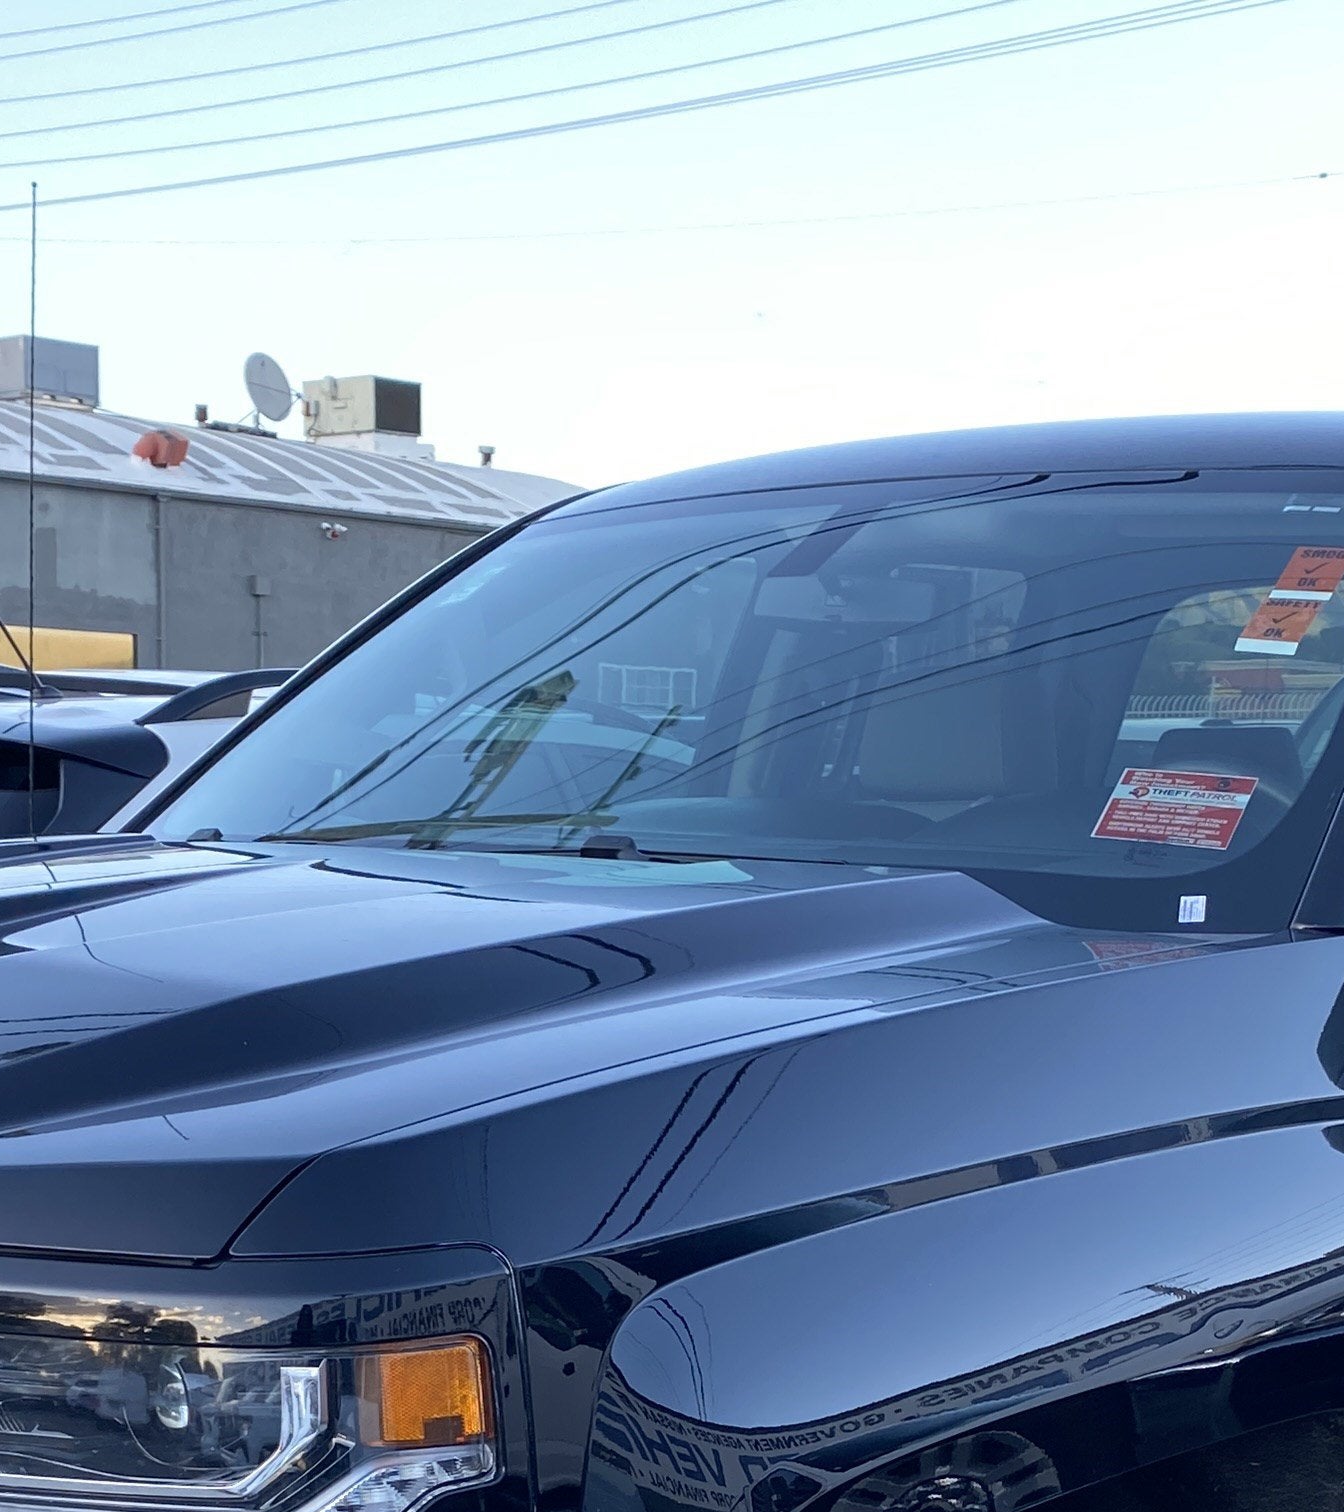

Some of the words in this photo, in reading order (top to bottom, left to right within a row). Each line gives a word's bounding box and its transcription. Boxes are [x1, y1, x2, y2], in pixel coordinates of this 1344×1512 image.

[1296, 577, 1319, 587] OK
[1263, 627, 1285, 638] OK
[1152, 788, 1191, 797] THEFT
[1190, 791, 1238, 802] PATROL
